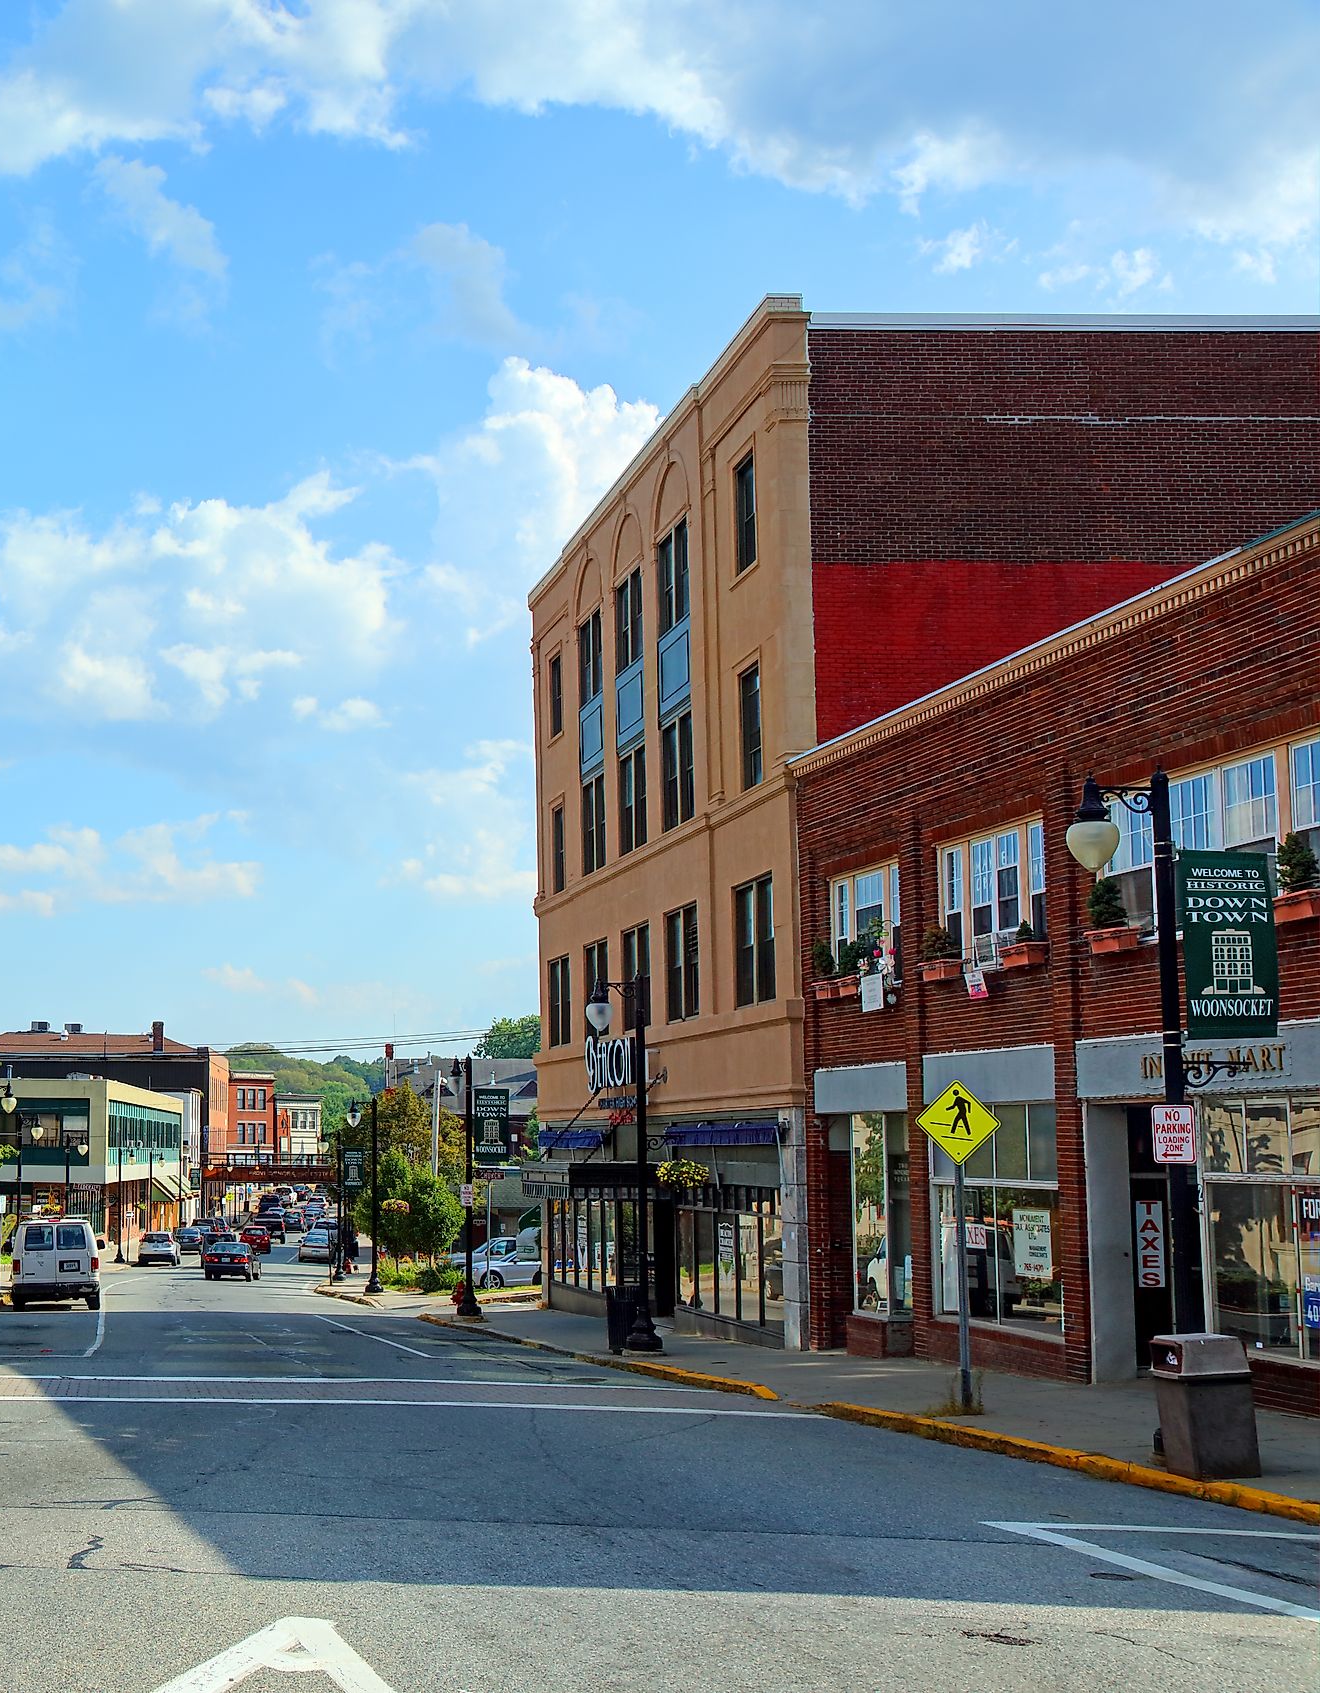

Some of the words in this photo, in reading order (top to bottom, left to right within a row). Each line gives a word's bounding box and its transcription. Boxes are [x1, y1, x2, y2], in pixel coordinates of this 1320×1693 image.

[1191, 867, 1244, 879] WELCOME
[1245, 869, 1260, 880] TO
[1186, 880, 1266, 891] HISTORIC
[1186, 896, 1269, 910] DOWN
[1185, 911, 1269, 924] TOWN
[1190, 998, 1274, 1018] WOONSOCKET
[585, 1035, 632, 1094] BEACON
[1227, 1044, 1286, 1073] MART
[1164, 1110, 1181, 1122] NO
[1155, 1123, 1191, 1134] PARKING
[1158, 1136, 1190, 1144] LOADING
[475, 1145, 507, 1154] WOONSOCKET
[1165, 1144, 1184, 1152] ZONE
[1139, 1199, 1161, 1287] TAXES
